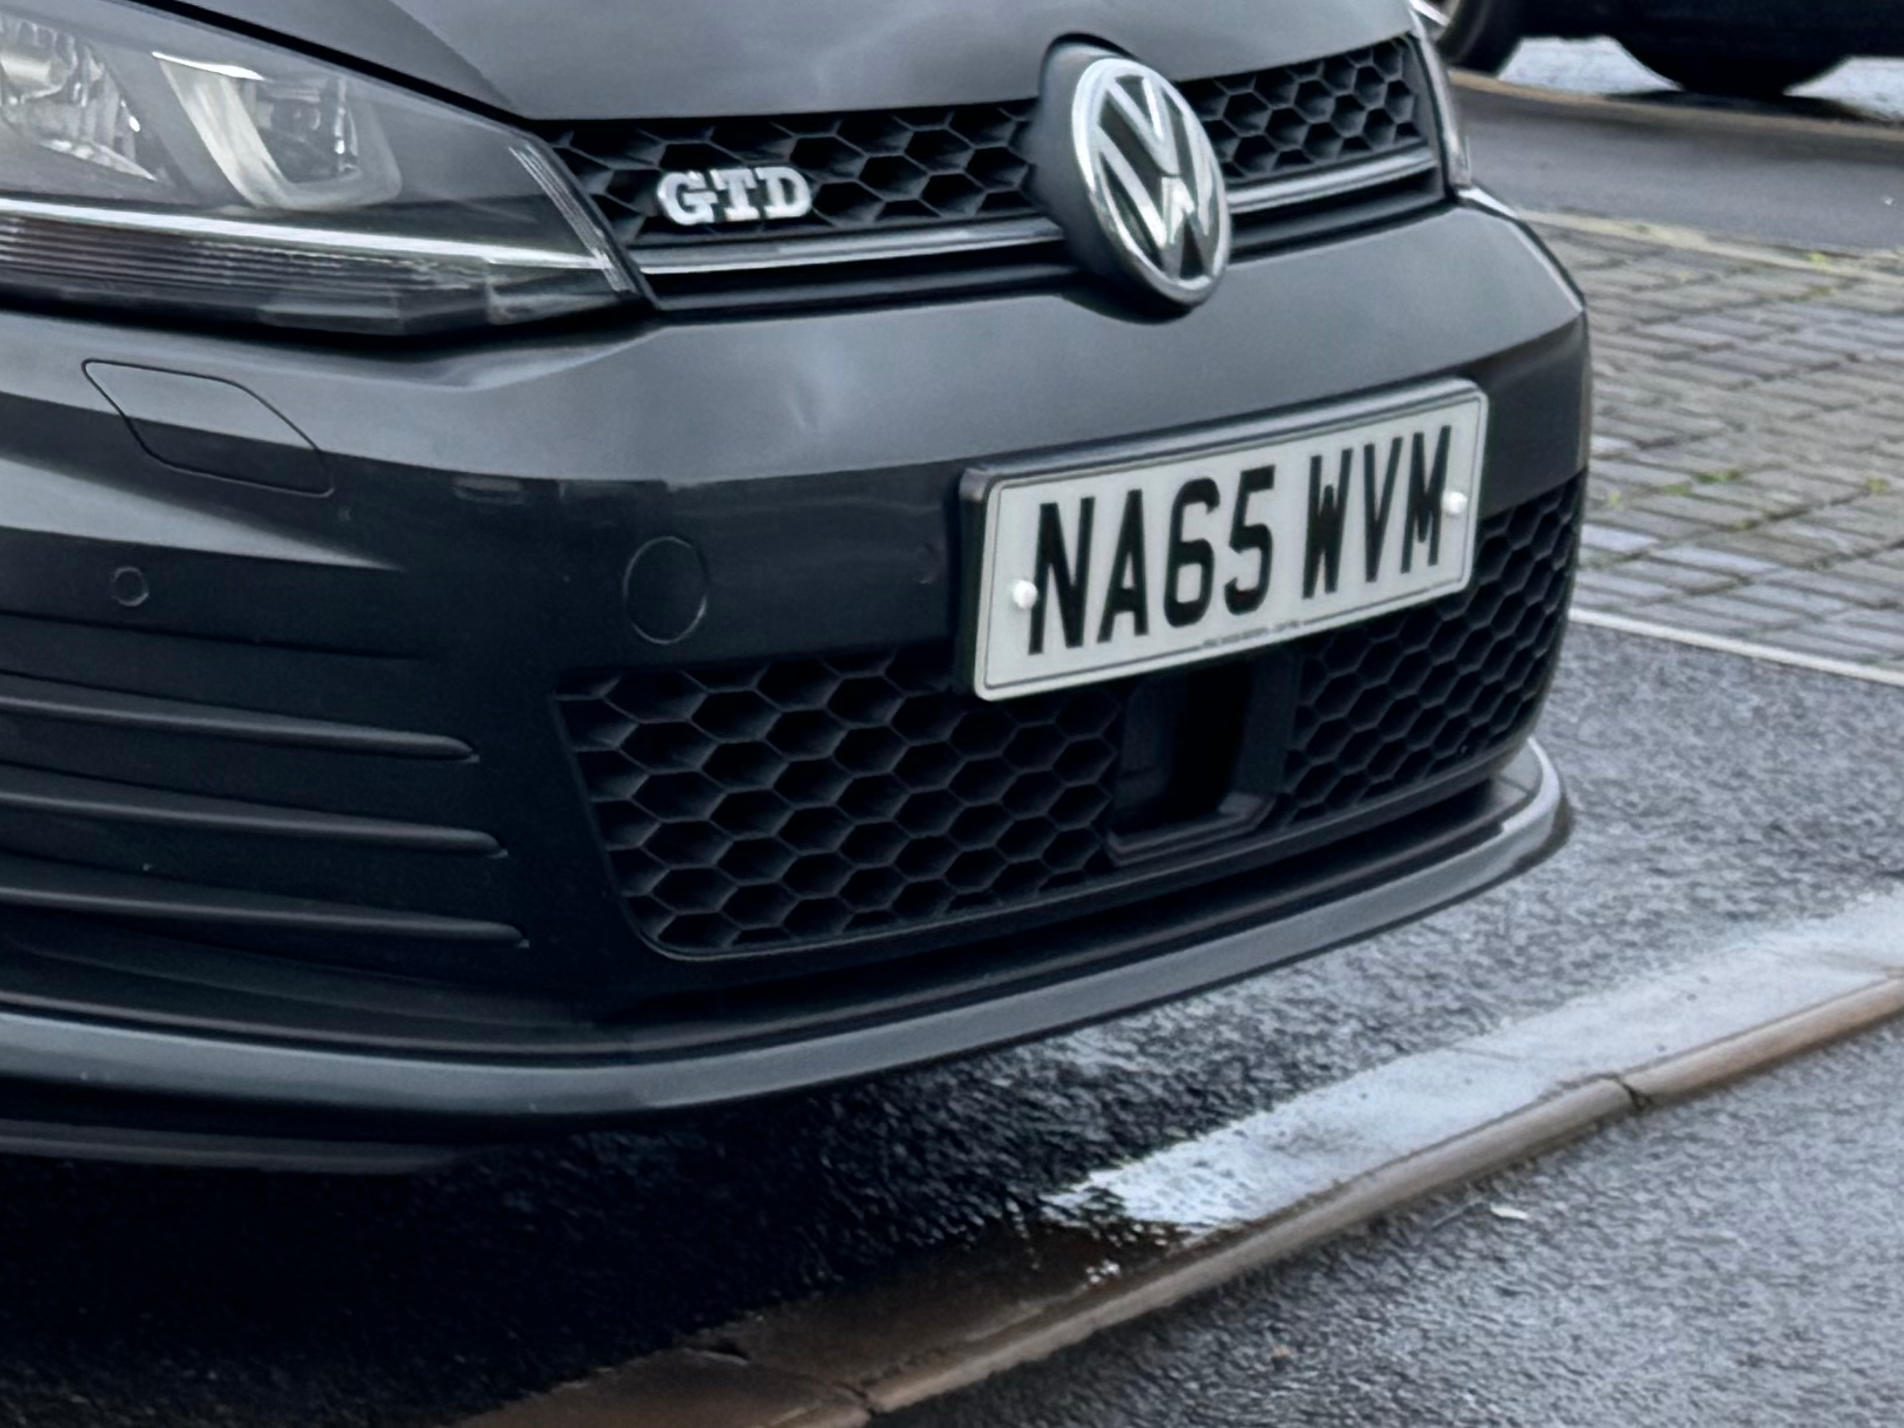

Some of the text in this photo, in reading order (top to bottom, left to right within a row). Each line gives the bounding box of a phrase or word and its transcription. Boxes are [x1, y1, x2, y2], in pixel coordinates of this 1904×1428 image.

[657, 166, 812, 226] GTD
[1028, 425, 1452, 656] NA65 WVM
